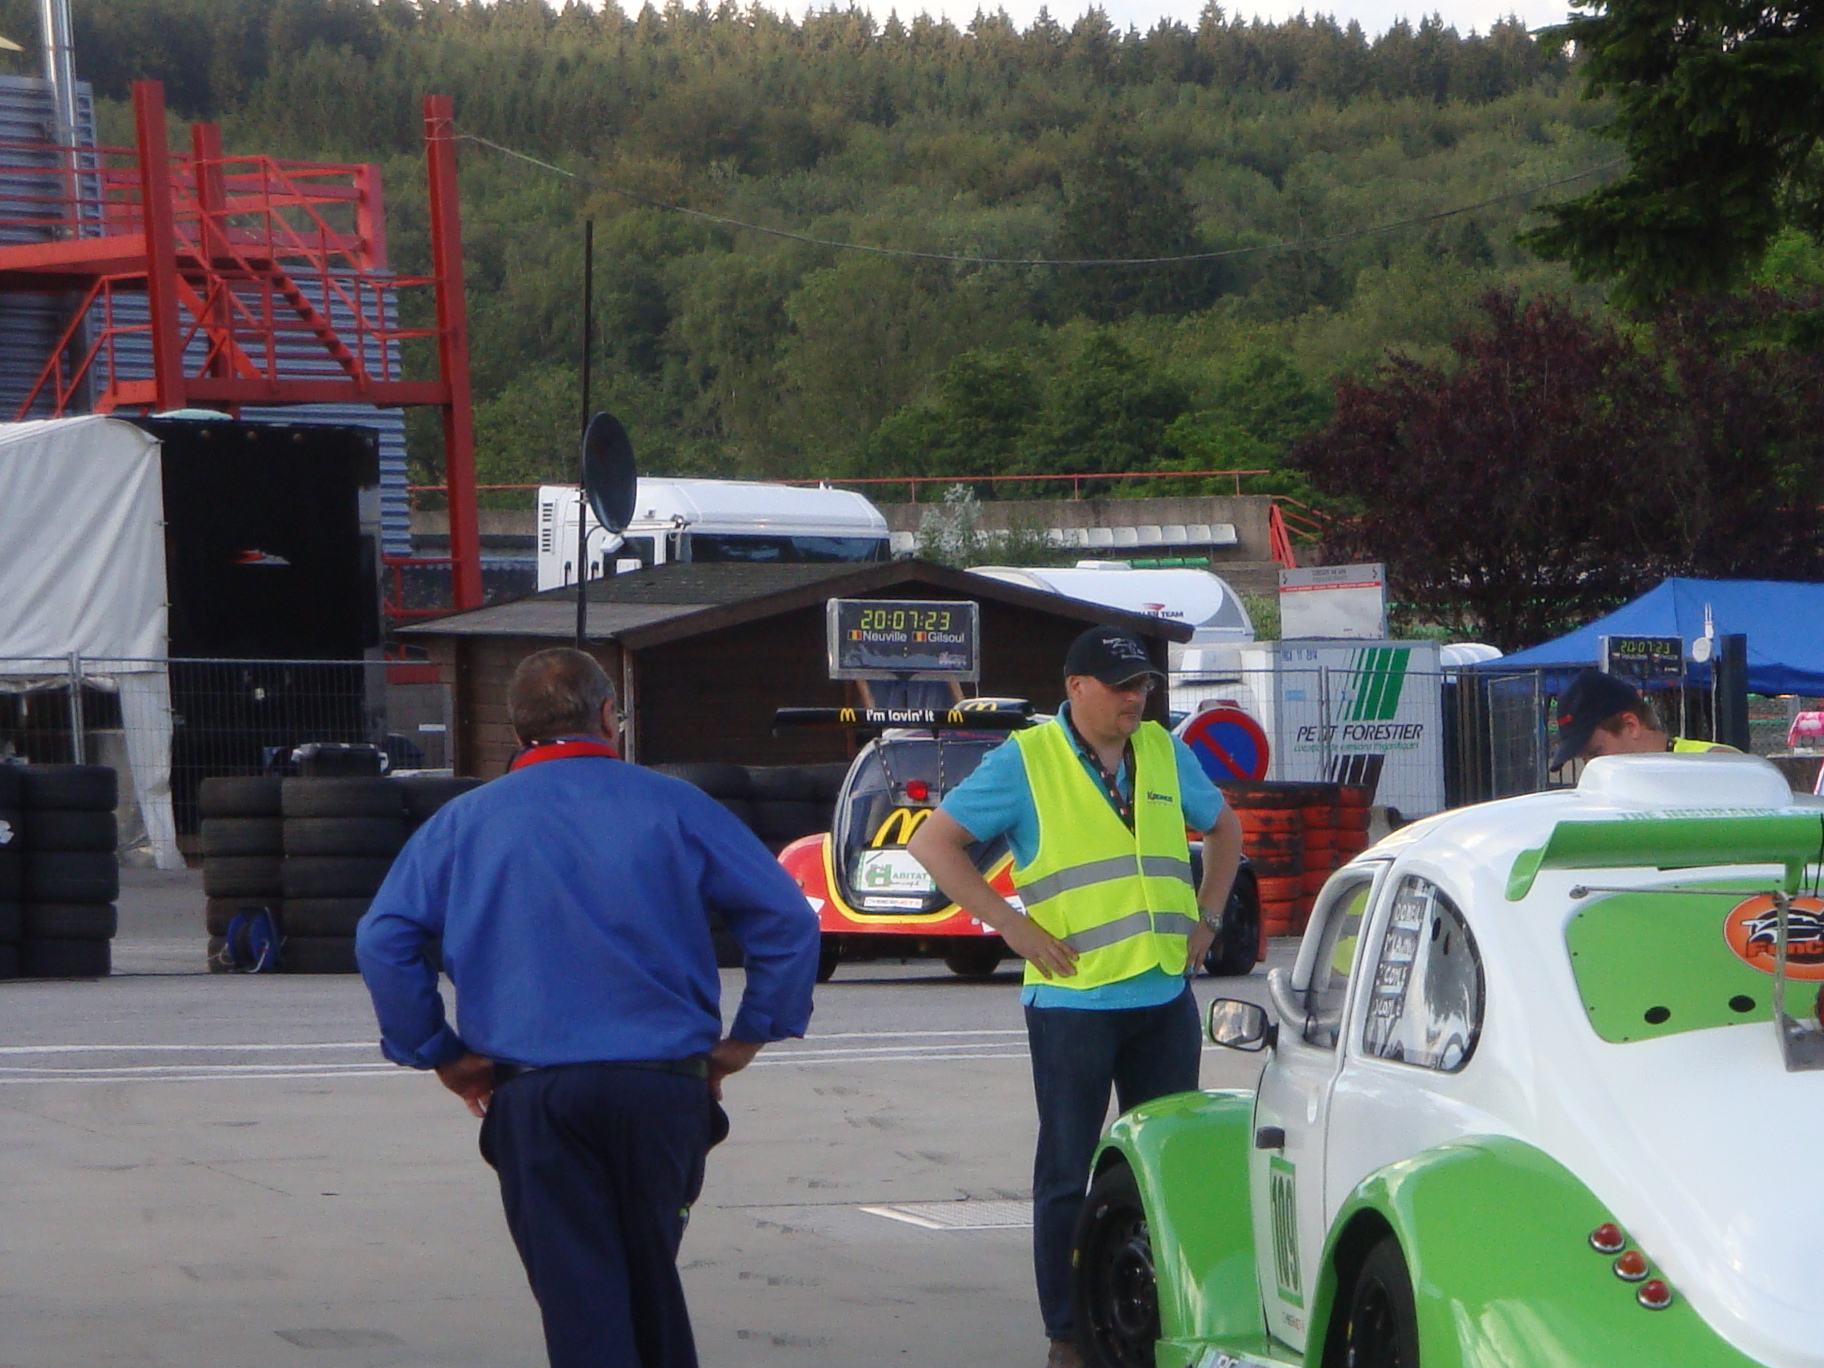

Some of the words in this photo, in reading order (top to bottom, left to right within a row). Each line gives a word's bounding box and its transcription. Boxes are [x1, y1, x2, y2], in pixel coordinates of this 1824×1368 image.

[861, 610, 950, 630] 20:07:23
[863, 630, 907, 642] Neuville
[928, 631, 965, 643] Gilsoul
[888, 709, 923, 722] lovin'
[1343, 724, 1424, 740] FORESTIER
